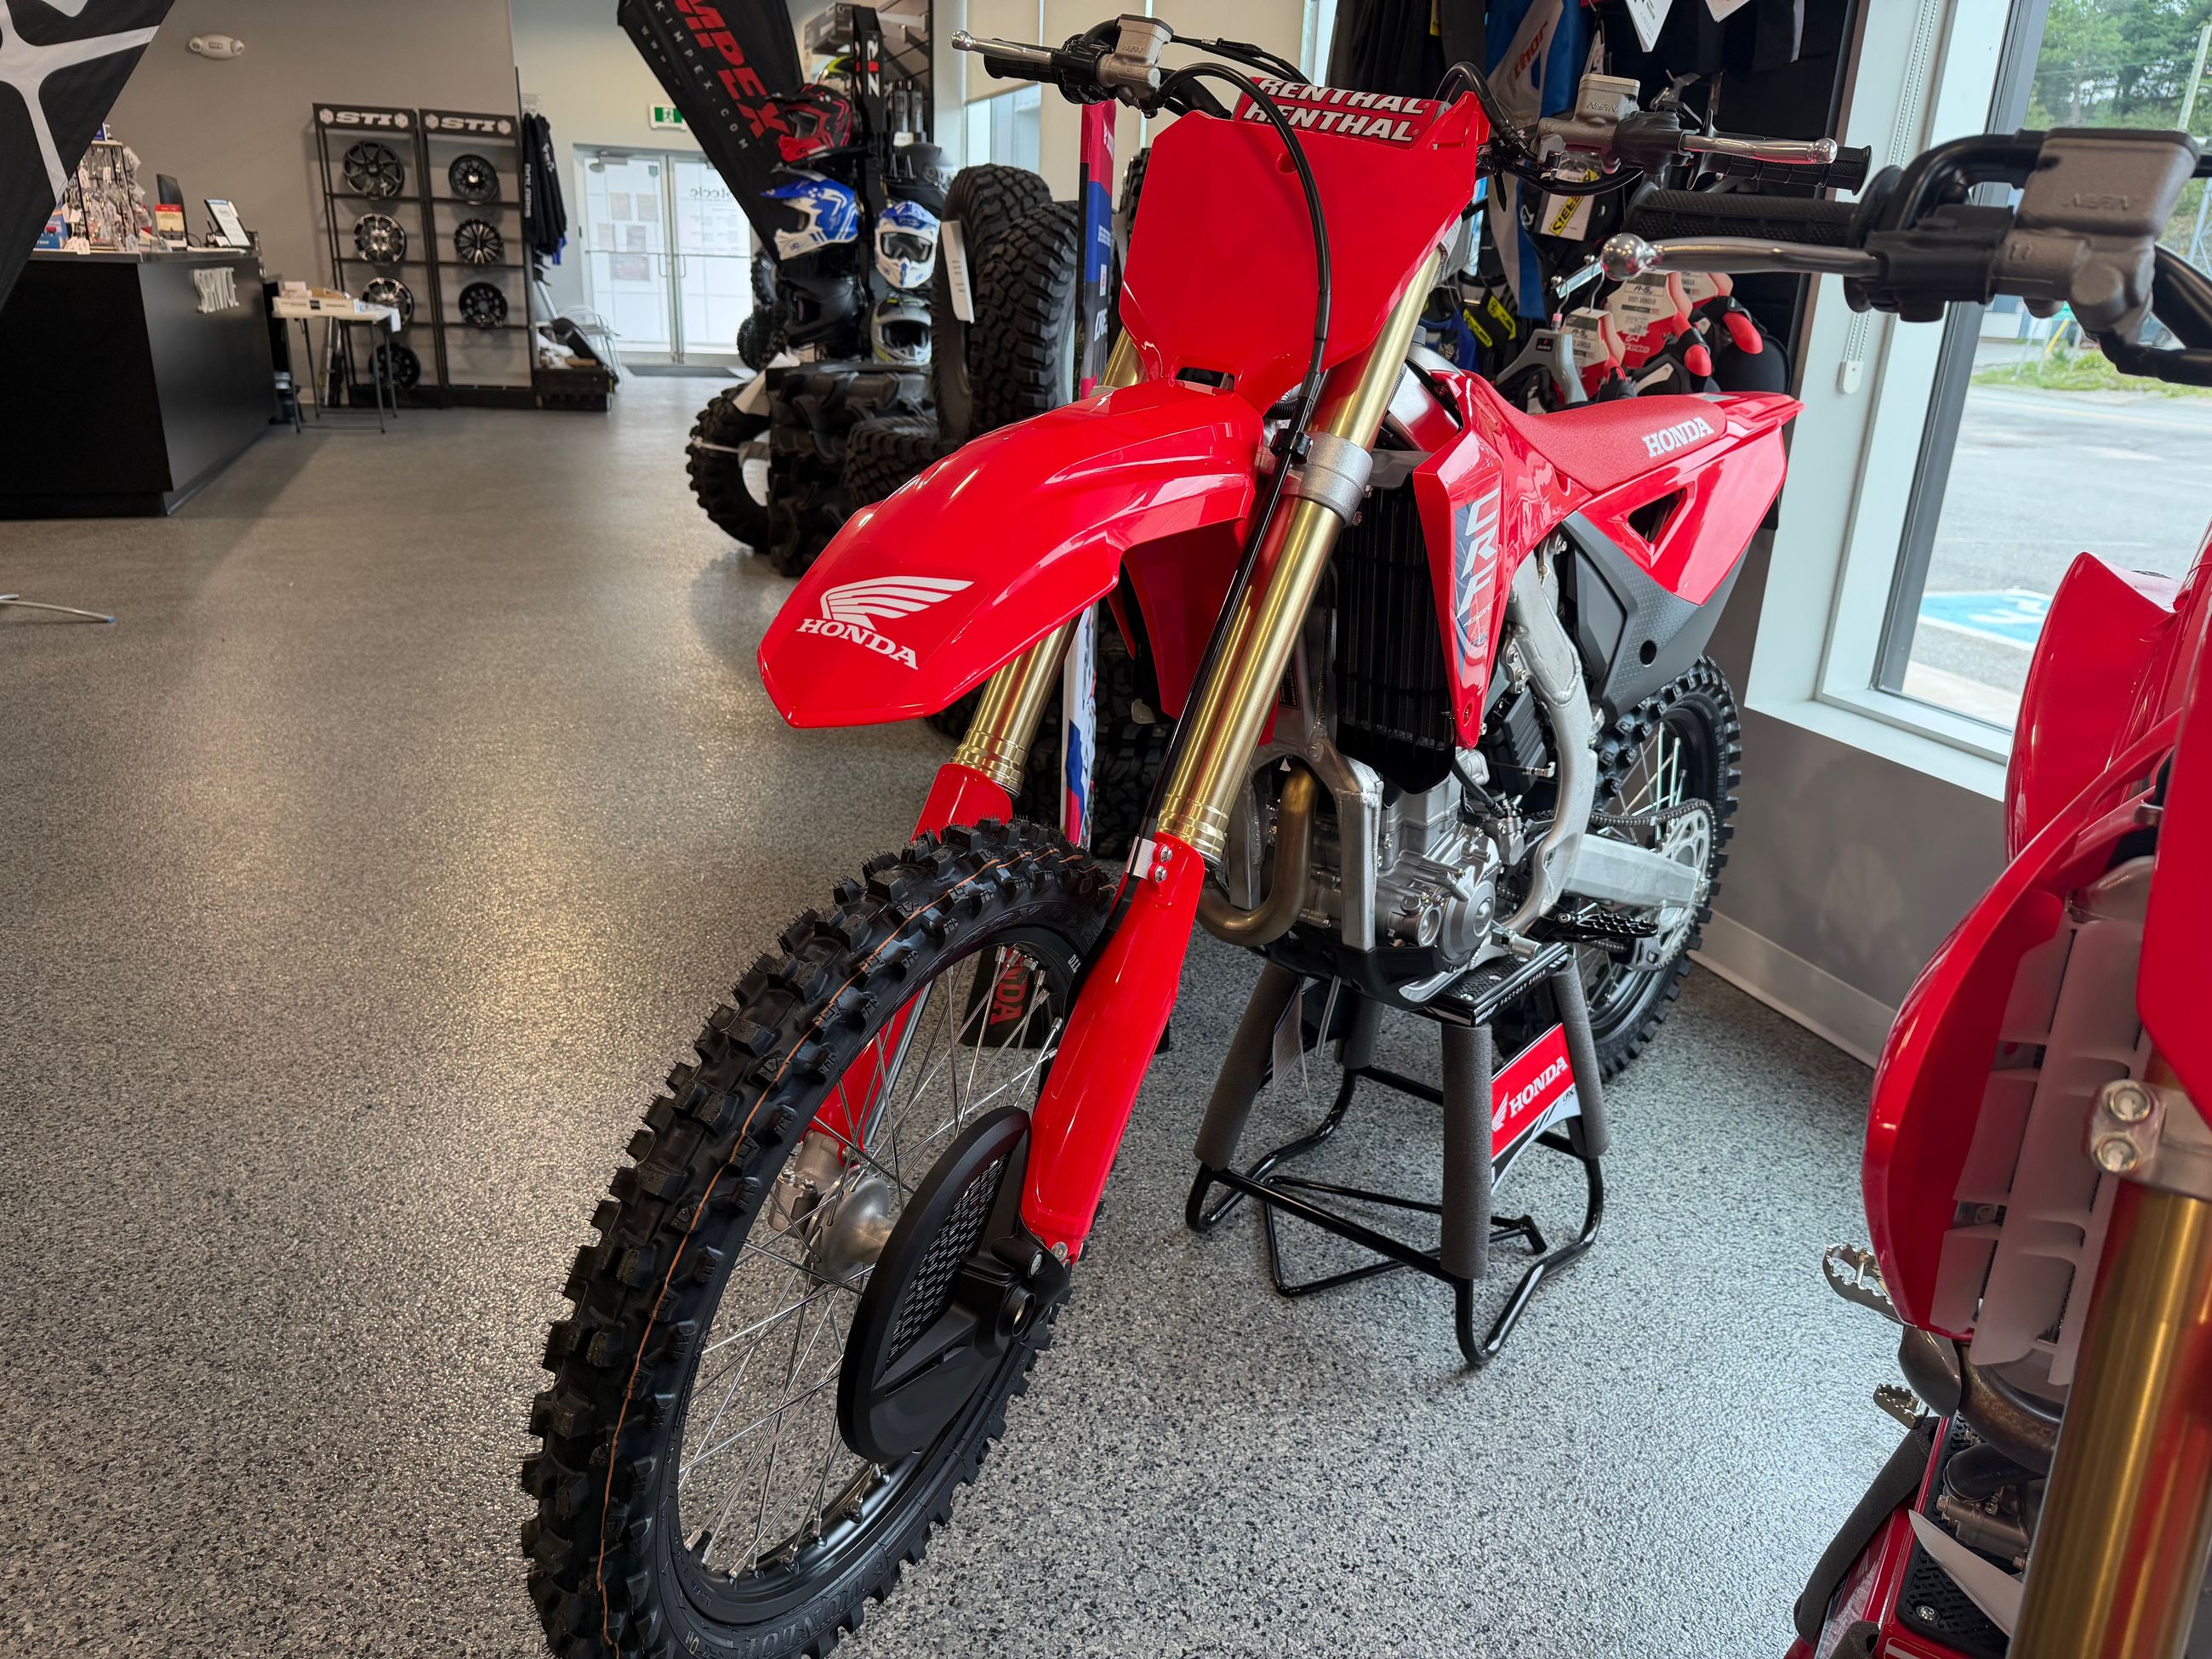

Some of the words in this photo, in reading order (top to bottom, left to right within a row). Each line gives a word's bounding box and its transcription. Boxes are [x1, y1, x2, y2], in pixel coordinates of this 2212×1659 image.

[1514, 20, 1548, 78] thor
[335, 111, 393, 126] STI
[1258, 78, 1425, 115] RENTHAL
[441, 117, 497, 133] STI
[1641, 416, 1714, 458] HONDA
[1456, 487, 1500, 619] CRF
[796, 618, 919, 670] HONDA
[1508, 1056, 1568, 1118] HONDA
